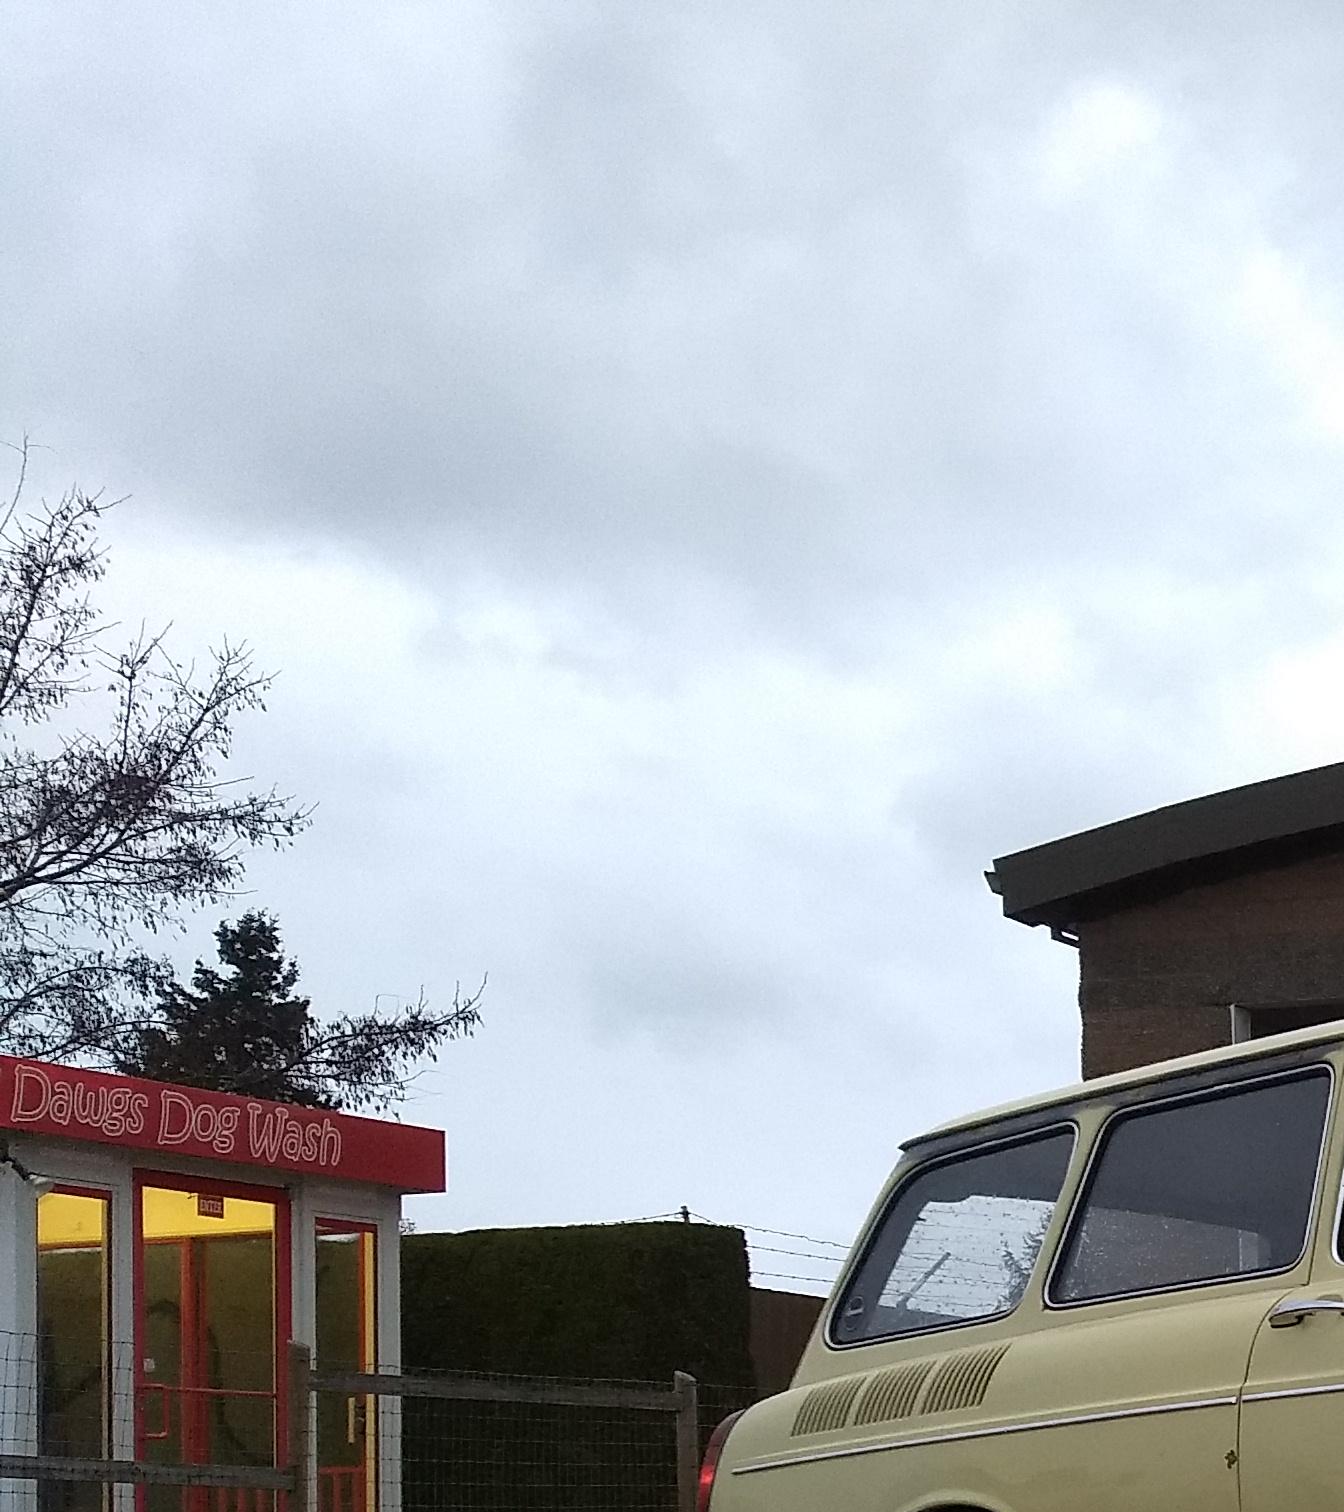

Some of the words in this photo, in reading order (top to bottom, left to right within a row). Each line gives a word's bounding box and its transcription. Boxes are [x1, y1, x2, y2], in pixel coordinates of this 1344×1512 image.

[11, 1064, 148, 1136] Dawgs
[158, 1090, 240, 1153] Dog
[249, 1103, 342, 1166] Wash
